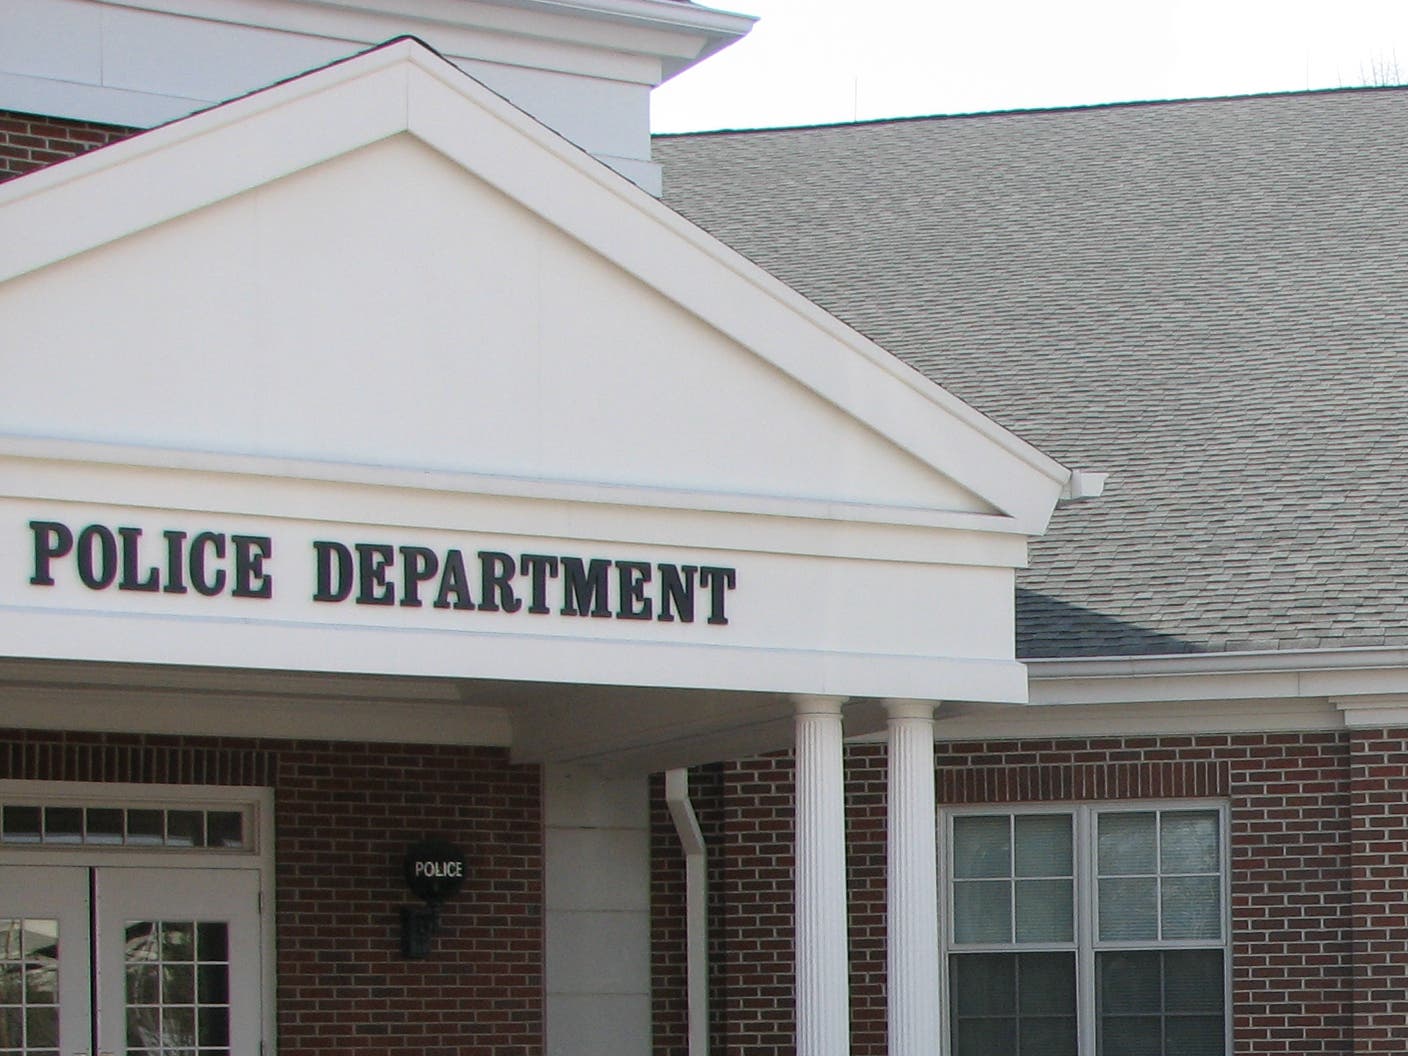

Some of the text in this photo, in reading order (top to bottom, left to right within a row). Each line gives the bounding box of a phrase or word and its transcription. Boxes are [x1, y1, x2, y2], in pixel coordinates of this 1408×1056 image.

[28, 520, 737, 626] POLICE DEPARTMENT
[415, 861, 463, 877] POLICE
